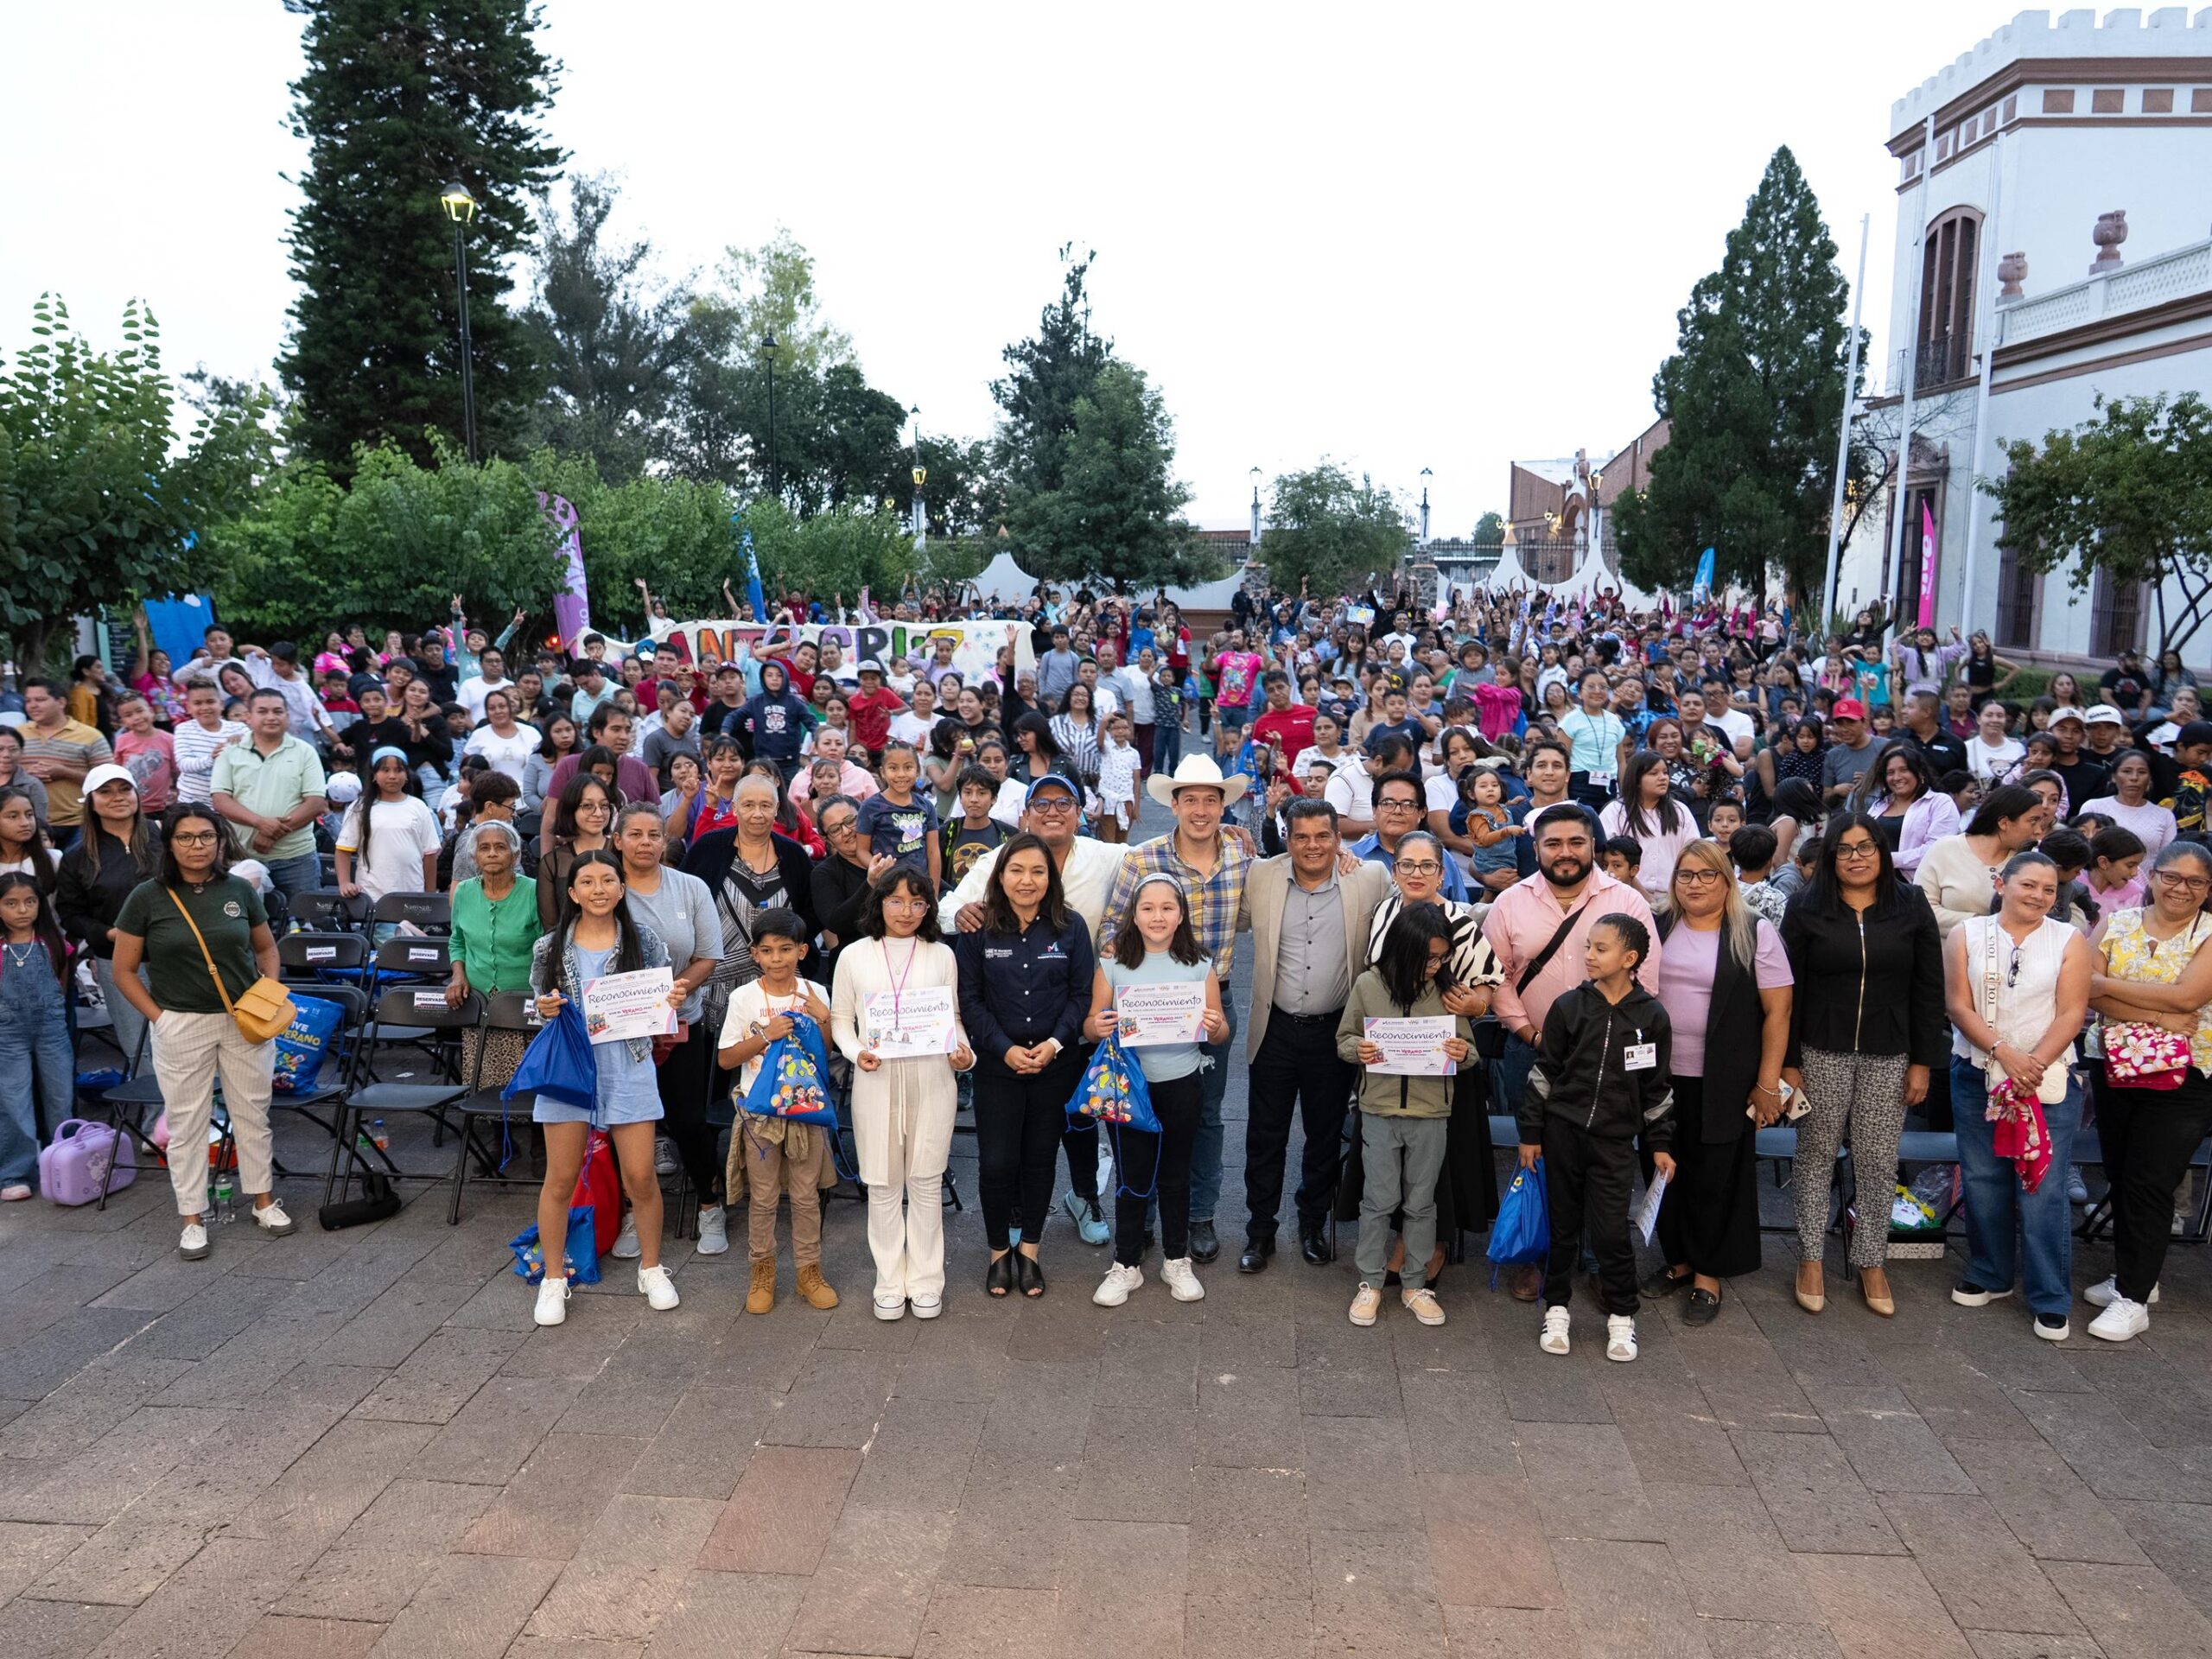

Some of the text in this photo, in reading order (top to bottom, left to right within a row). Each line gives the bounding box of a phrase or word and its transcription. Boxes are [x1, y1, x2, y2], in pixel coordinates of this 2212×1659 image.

[588, 982, 670, 1004] Reconocimiento
[1122, 995, 1202, 1007] Reconocimiento
[1987, 986, 1996, 1006] TOU
[869, 1001, 949, 1017] Reconocimiento
[291, 1020, 309, 1033] IVE
[1369, 1029, 1452, 1039] Reconocimiento
[282, 1029, 321, 1046] ERANO
